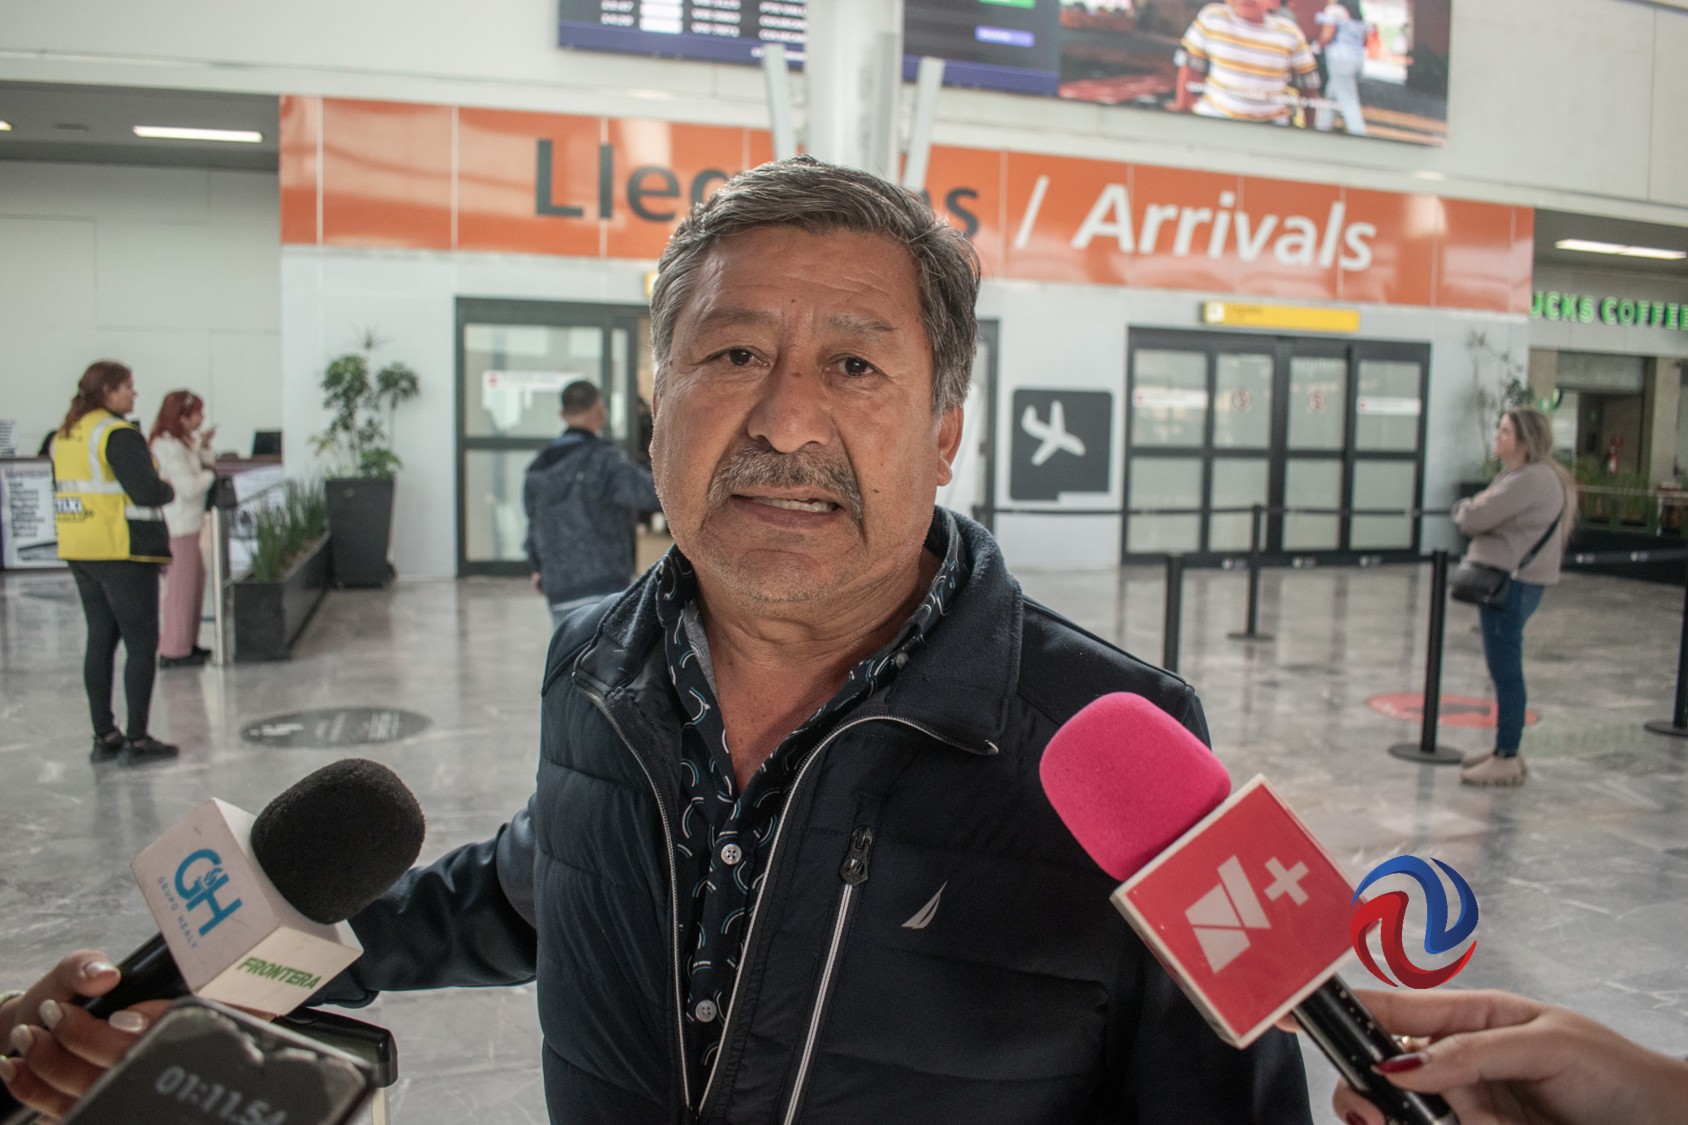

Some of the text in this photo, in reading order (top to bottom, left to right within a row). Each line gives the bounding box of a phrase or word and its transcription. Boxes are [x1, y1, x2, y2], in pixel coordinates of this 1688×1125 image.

[1071, 183, 1377, 271] Arrivals
[157, 875, 199, 949] GRUPO HEALY
[236, 956, 322, 989] FRONTERA
